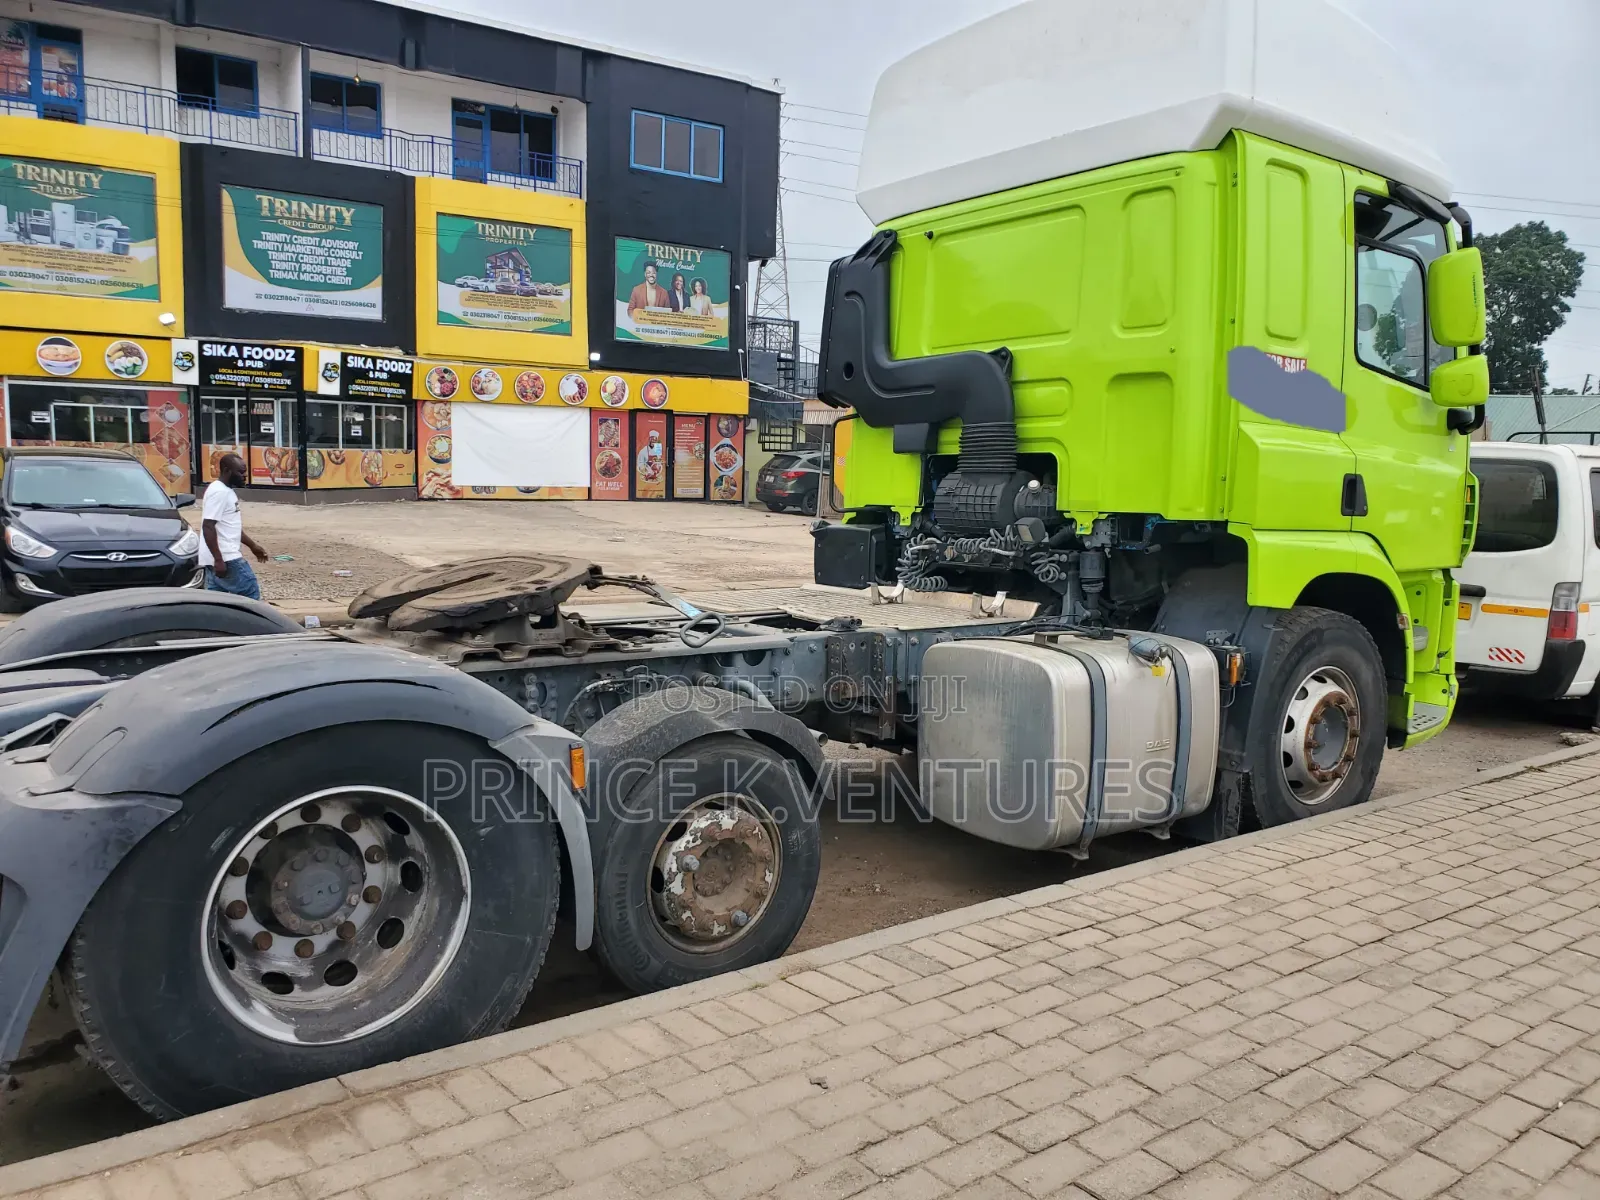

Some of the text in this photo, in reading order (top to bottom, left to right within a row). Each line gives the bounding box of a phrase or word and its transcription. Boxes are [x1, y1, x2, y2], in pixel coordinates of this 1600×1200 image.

[12, 162, 103, 189] TRINITY
[37, 183, 80, 196] TRADE
[255, 194, 356, 227] TRINITY
[277, 218, 335, 231] CREDIT GROUP
[474, 221, 537, 241] TRINITY
[261, 231, 360, 250] TRINITY CREDIT ADVISORY
[485, 237, 528, 246] PROPERTIES
[252, 240, 364, 260] TRINITY MARKETING CONSULT
[267, 250, 352, 268] TRINITY CREDIT TRADE
[645, 243, 704, 263] TRINITY
[270, 260, 347, 276] TRINITY PROPERTIES
[268, 269, 353, 286] TRIMAX MICRO CREDIT
[202, 343, 296, 362] SIKA FOODZ
[237, 369, 269, 377] CONTINENTAL
[245, 360, 264, 369] PUB
[346, 355, 412, 374] SIKA FOODZ
[374, 371, 388, 380] PUB
